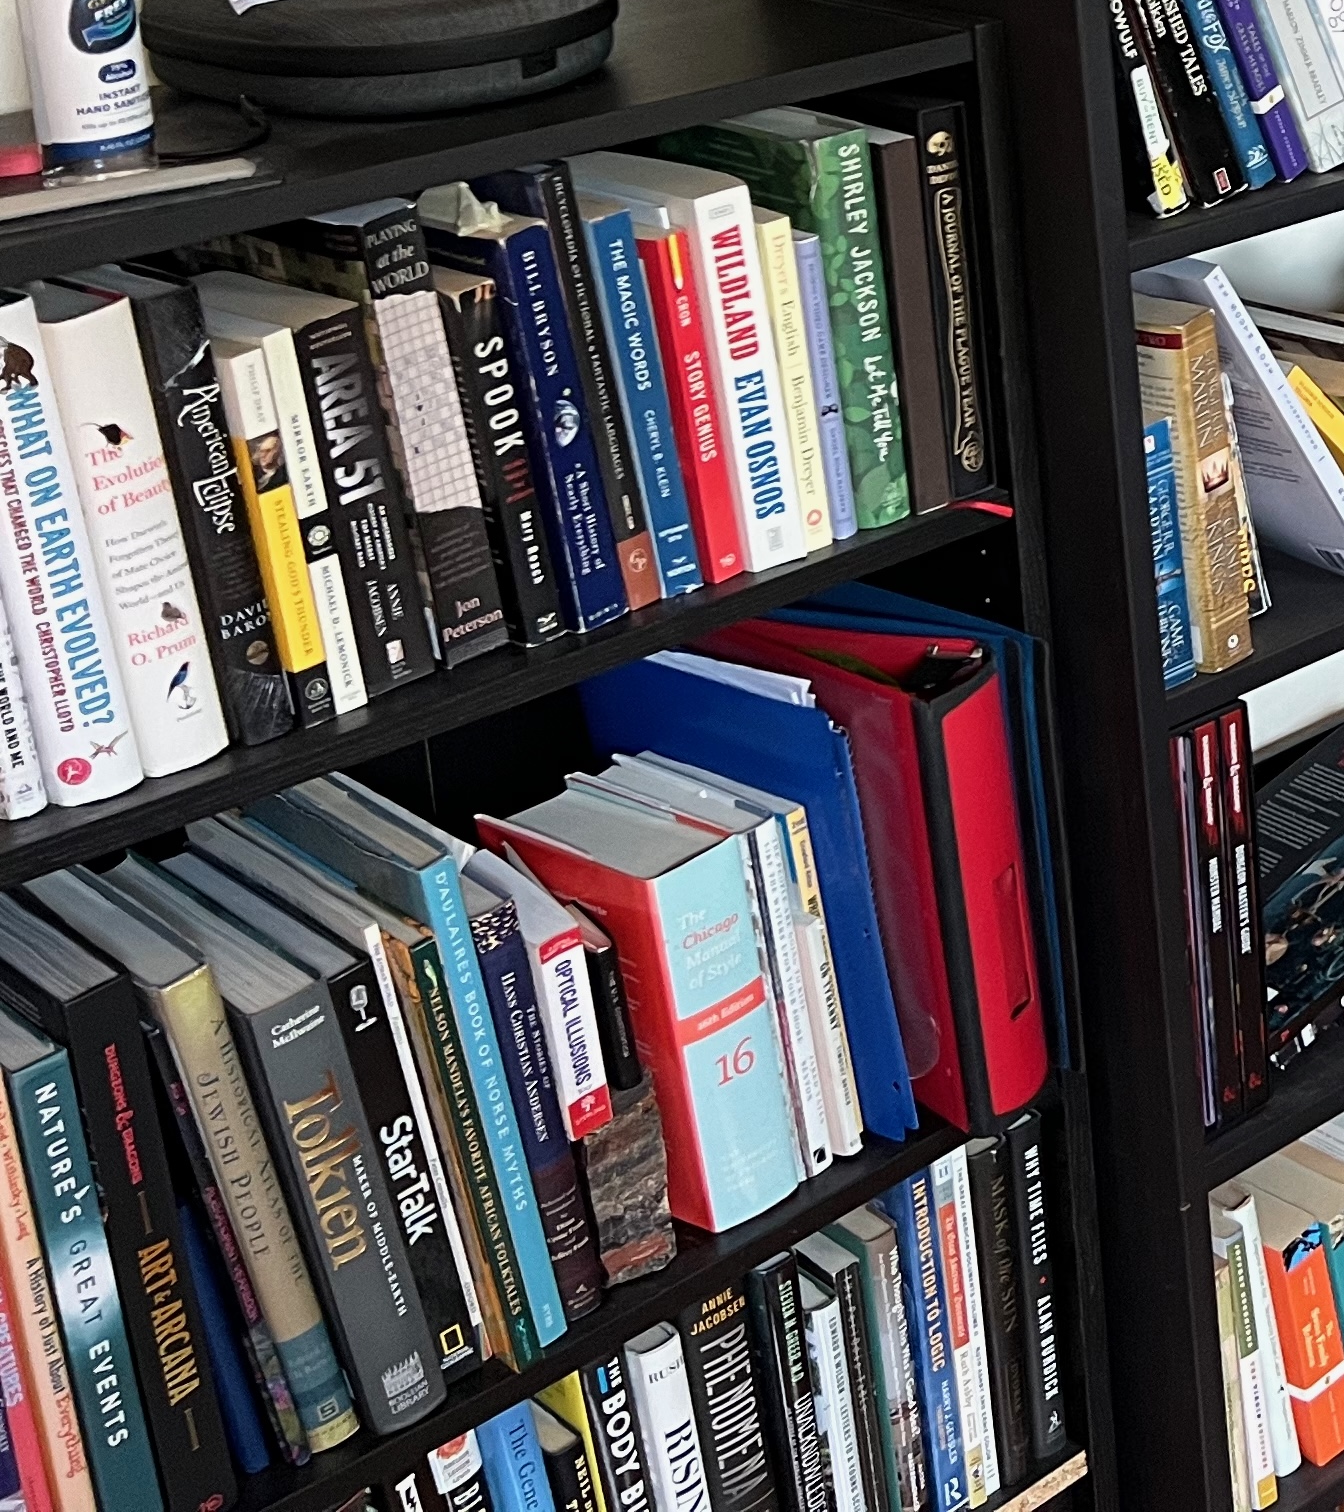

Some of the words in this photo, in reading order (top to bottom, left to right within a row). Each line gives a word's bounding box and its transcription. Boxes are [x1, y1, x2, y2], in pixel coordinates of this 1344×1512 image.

[99, 83, 142, 101] INSTANT
[1180, 44, 1206, 95] TALES
[76, 103, 111, 116] HAND
[1136, 78, 1147, 101] BUY
[1144, 114, 1157, 144] RENT
[838, 143, 867, 232] SHIRLEY
[365, 219, 417, 248] PLAYING
[376, 254, 390, 268] at
[391, 244, 414, 262] the
[608, 239, 627, 271] THE
[941, 205, 960, 274] JOURNAL
[371, 261, 429, 294] WORLD
[616, 275, 638, 329] MAGIC
[711, 225, 758, 360] WILDLAND
[850, 246, 881, 341] JACKSON
[948, 273, 963, 295] OF
[521, 250, 541, 295] BILL
[531, 300, 557, 376] BRYSON
[950, 293, 966, 327] THE
[628, 332, 651, 390] WORDS
[684, 351, 705, 399] STORY
[863, 355, 886, 382] Let
[953, 325, 972, 387] PLAGUE
[2, 382, 52, 460] WHAT
[312, 348, 377, 459] AREA
[474, 336, 524, 455] SPOOK
[734, 370, 771, 438] EVAN
[780, 300, 799, 356] English
[791, 375, 807, 444] Benjamin
[800, 447, 814, 494] Dreyer
[867, 383, 887, 406] Me
[869, 403, 892, 432] Tell
[959, 386, 977, 429] YEAR
[1185, 355, 1211, 447] MARTIN
[177, 383, 232, 476] American
[694, 401, 716, 461] GENIUS
[873, 431, 893, 461] You
[2, 469, 18, 495] THAT
[25, 466, 62, 506] ON
[193, 467, 238, 534] Eclipse
[334, 462, 371, 506] 51
[745, 440, 784, 519] OSNOS
[8, 498, 31, 551] CHANGED
[18, 549, 37, 575] THE
[31, 503, 86, 602] EARTH
[24, 574, 45, 616] WORLD
[455, 597, 481, 619] Jon
[442, 609, 504, 642] Peterson
[35, 621, 65, 697] CHRISTOPHER
[54, 699, 74, 732] LLOYD
[55, 598, 113, 727] EVOLVED?
[682, 912, 740, 950] Chicago
[554, 959, 578, 1016] OPTICAL
[434, 871, 471, 983] D'AULAIRES'
[464, 990, 485, 1041] BOOK
[478, 1044, 492, 1067] OF
[485, 1075, 509, 1139] NORSE
[501, 1144, 527, 1210] MYTHS
[500, 971, 516, 1008] HANS
[510, 1009, 532, 1077] CHRISTIAN
[524, 1080, 547, 1141] ANDERSEN
[565, 1016, 591, 1085] ILLUSIONS
[714, 1035, 756, 1088] 16
[199, 1076, 239, 1164] JEWISH
[224, 1172, 271, 1266] PEOPLE
[283, 1071, 368, 1272] Tolkien
[430, 986, 449, 1041] NELSON
[442, 1042, 469, 1117] MANDELA'S
[462, 1118, 486, 1182] FAVORITE
[479, 1185, 500, 1240] AFRICAN
[494, 1241, 521, 1315] FOLKTALES
[1024, 1145, 1039, 1178] WHY
[379, 1115, 437, 1245] StarTalk
[1027, 1181, 1043, 1220] TIME
[352, 1154, 371, 1199] MAKER
[366, 1201, 377, 1217] OF
[372, 1222, 406, 1316] MIDDLE-EARTH
[912, 1175, 939, 1299] INTRODUCTION
[1030, 1221, 1047, 1264] FLIES
[34, 1082, 86, 1223] NATURE'S
[67, 1238, 104, 1327] GREAT
[88, 1339, 127, 1446] EVENTS
[137, 1239, 176, 1293] ART
[690, 1295, 746, 1336] JACOBSEN
[702, 1287, 733, 1315] ANNIE
[926, 1297, 939, 1321] TO
[1037, 1295, 1052, 1333] ALAN
[151, 1300, 199, 1406] ARCANA
[607, 1357, 621, 1387] THE
[928, 1322, 944, 1371] LOGIC
[1040, 1334, 1058, 1399] BURDICK
[602, 1390, 639, 1475] BODY
[700, 1323, 767, 1498] PHENOMENA
[574, 1454, 590, 1498] NEIL
